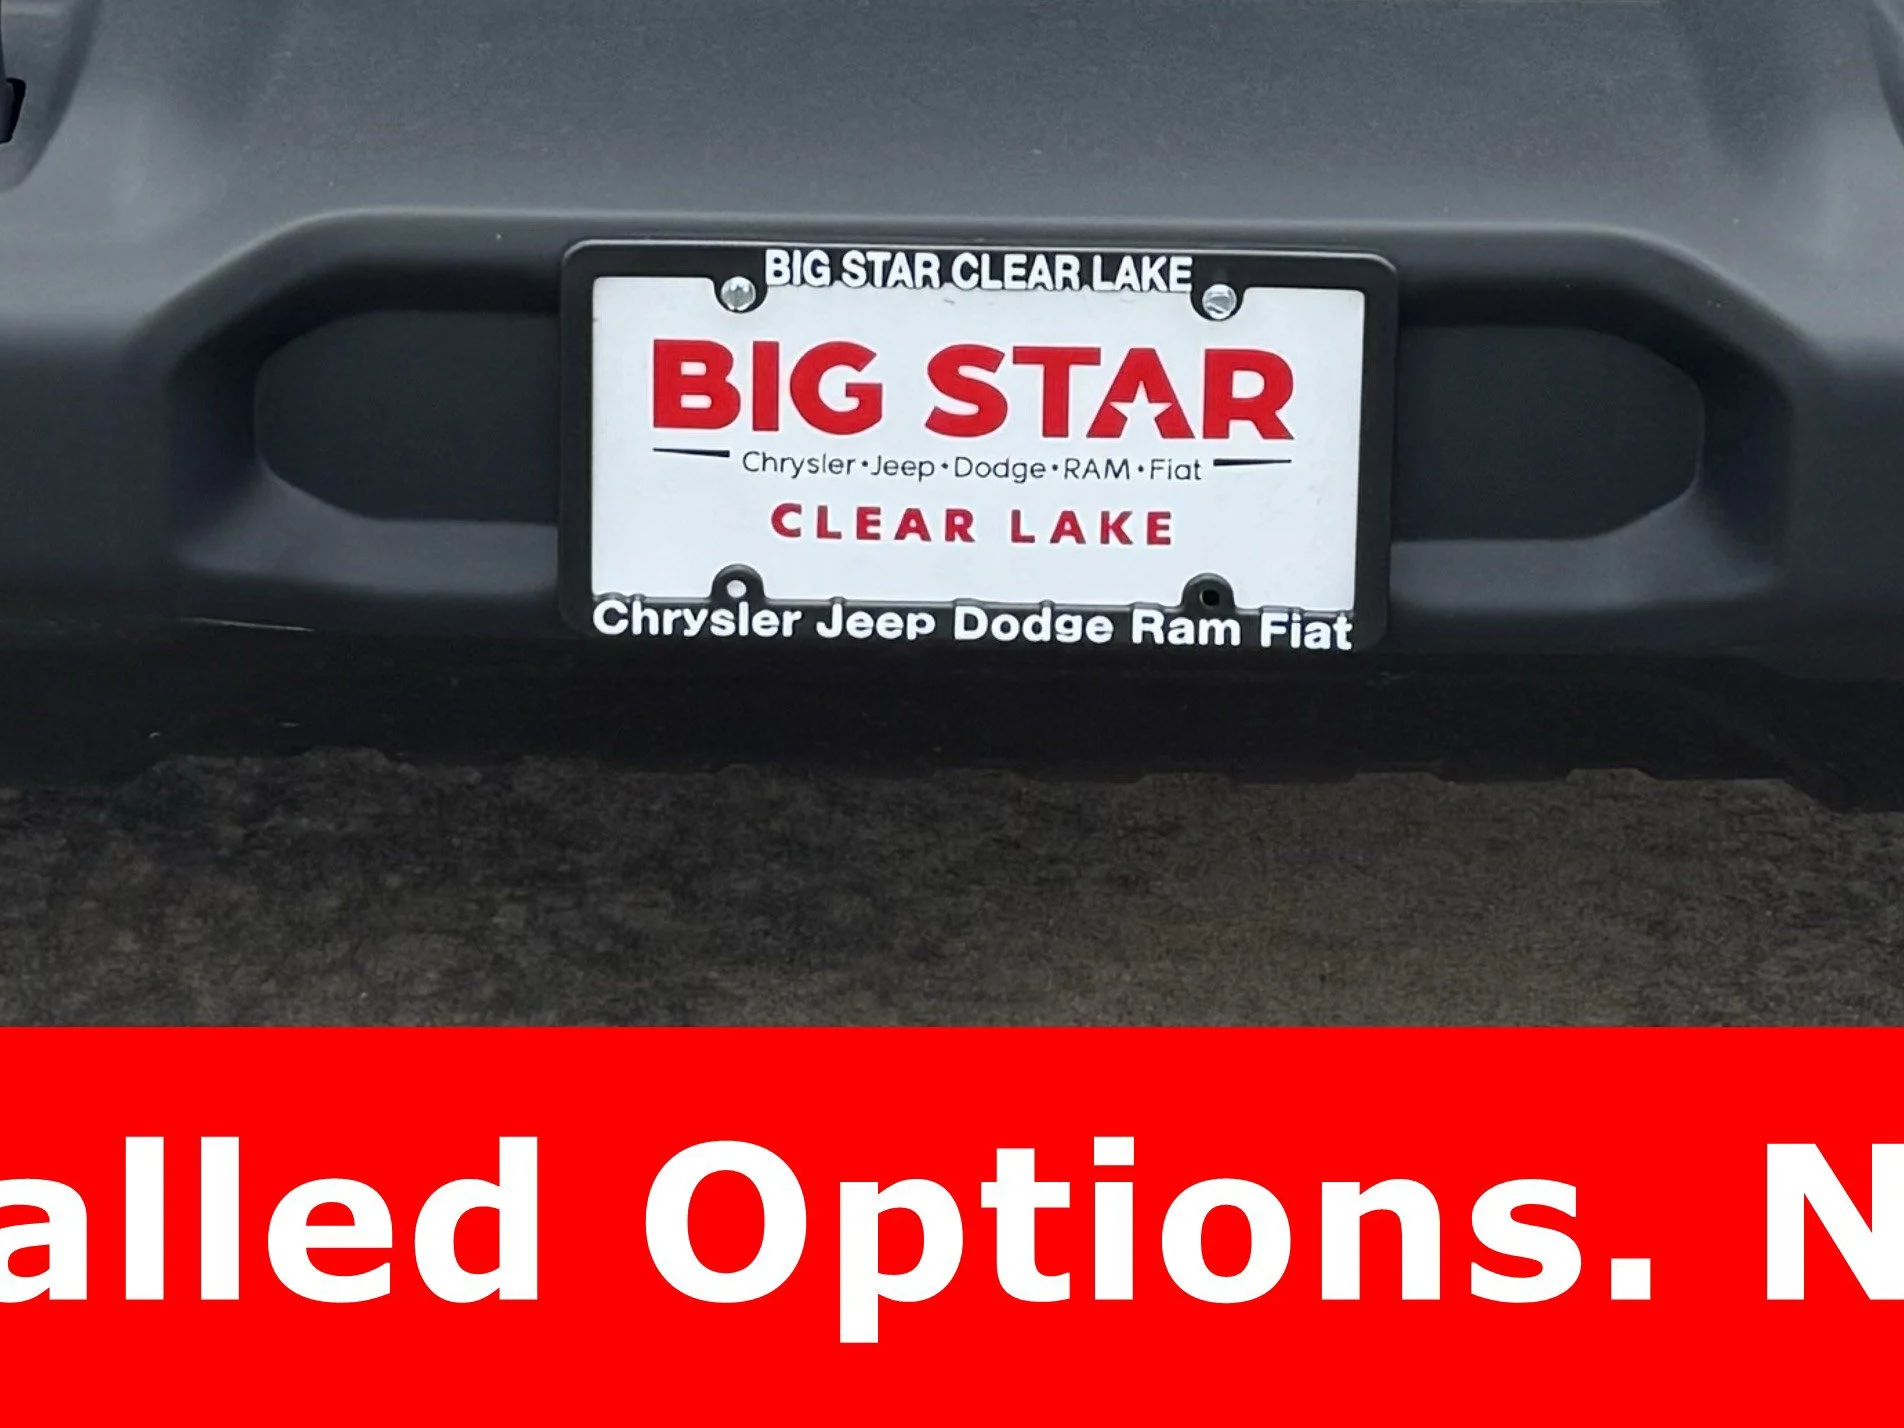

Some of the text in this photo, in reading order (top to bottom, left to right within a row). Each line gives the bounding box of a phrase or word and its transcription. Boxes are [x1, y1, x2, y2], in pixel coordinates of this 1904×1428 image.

[765, 248, 1193, 293] BIG STAR CLEAR LAKE
[652, 338, 1296, 440] BIG STAR
[742, 450, 1202, 484] Chrysler Jeep Dodge RAM Fiat
[770, 502, 1173, 546] CLEAR LAKE
[592, 599, 1354, 651] Chrysler Jeep Dodge Ram Fiat
